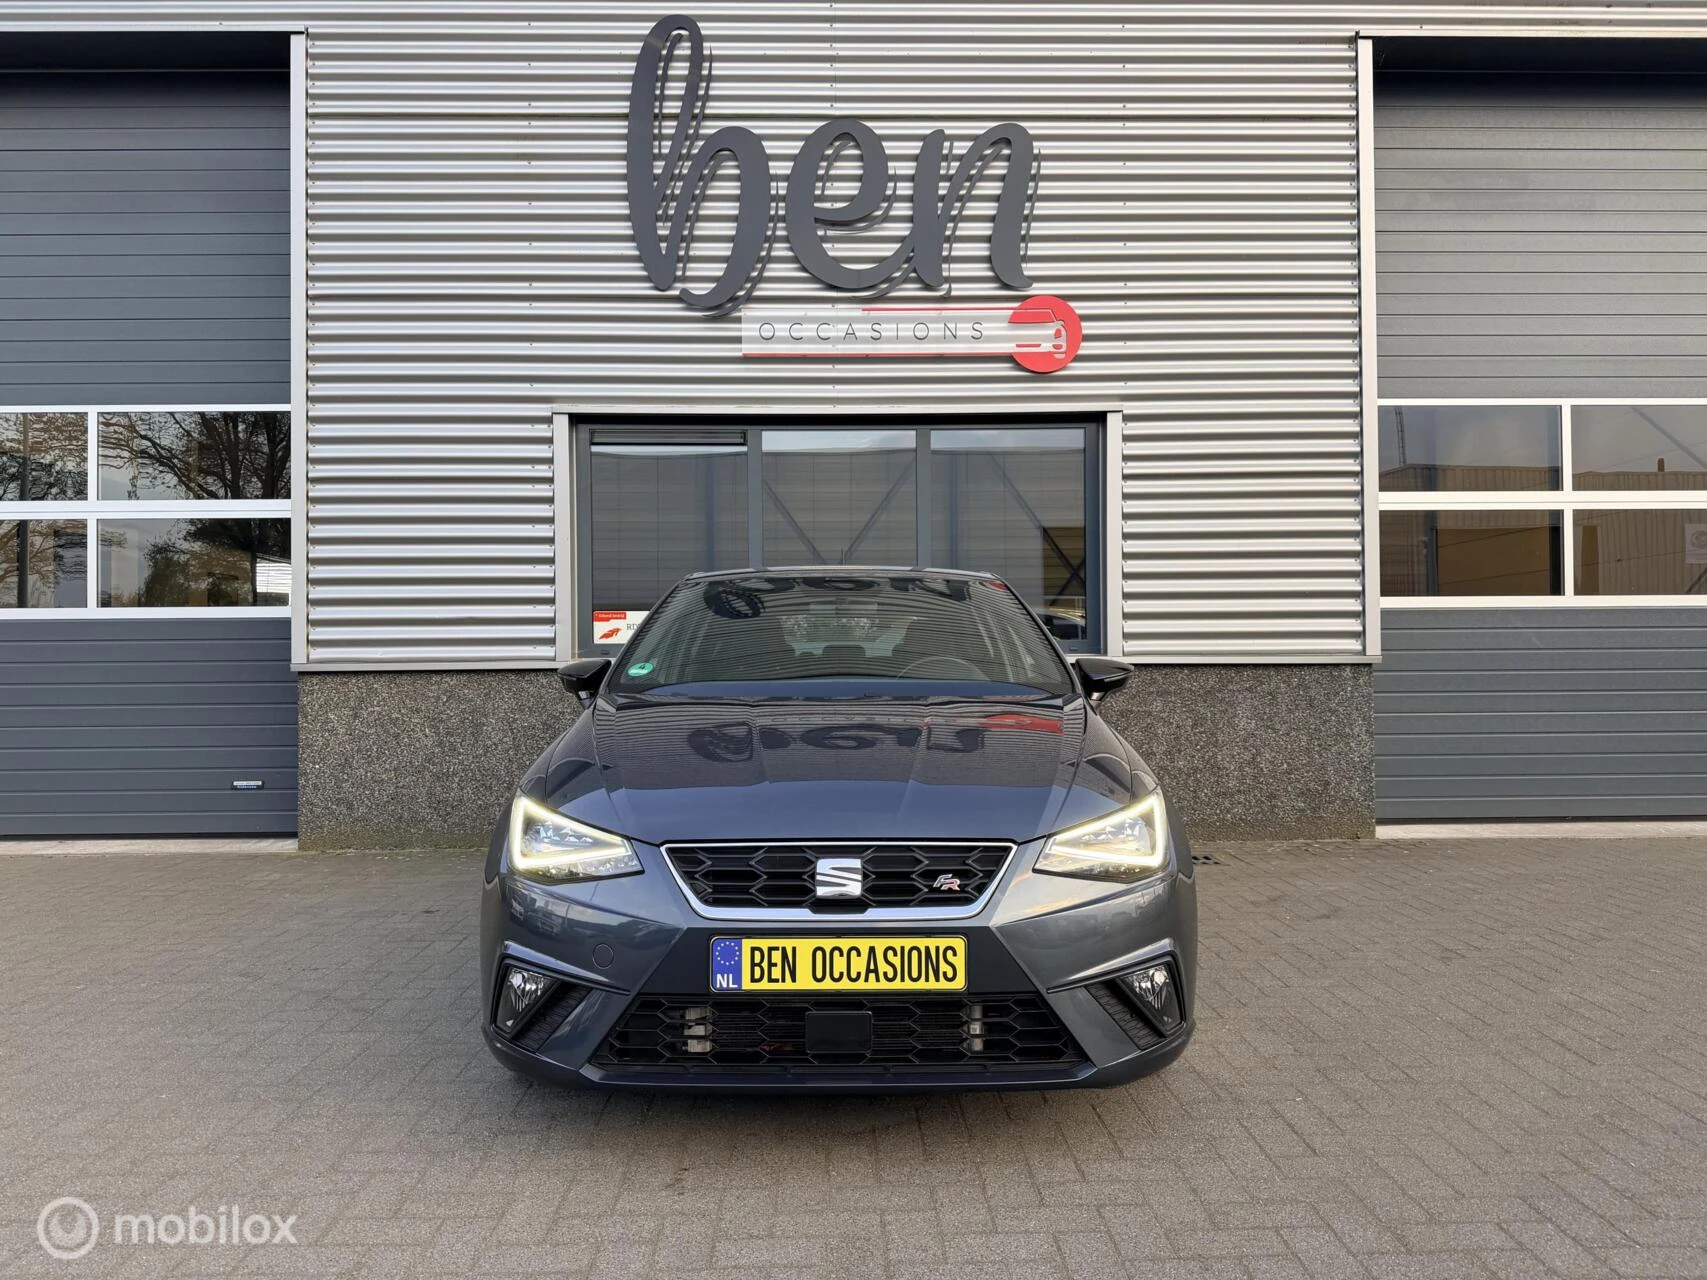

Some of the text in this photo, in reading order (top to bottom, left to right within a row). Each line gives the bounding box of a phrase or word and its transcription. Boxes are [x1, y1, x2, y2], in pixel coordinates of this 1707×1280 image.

[626, 14, 1036, 311] ben
[758, 321, 984, 341] OCCASIONS
[932, 873, 961, 891] FR
[749, 945, 959, 984] BEN OCCASIONS
[716, 973, 738, 988] NL
